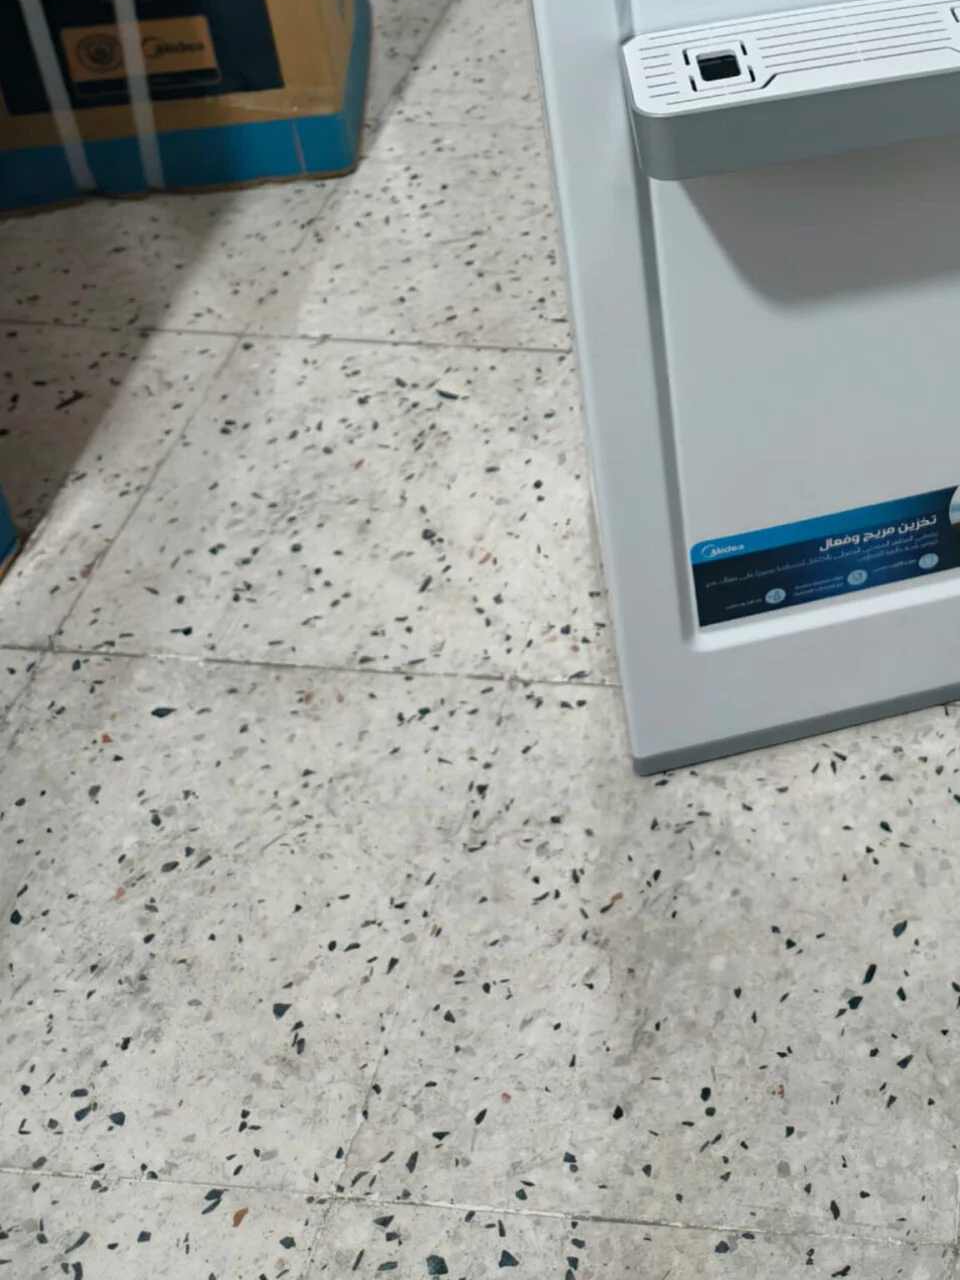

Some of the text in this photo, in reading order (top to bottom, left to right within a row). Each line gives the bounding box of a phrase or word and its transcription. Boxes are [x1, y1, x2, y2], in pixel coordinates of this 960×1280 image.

[862, 526, 896, 542] مريح
[897, 514, 938, 535] تخزين
[818, 534, 860, 553] وفعال
